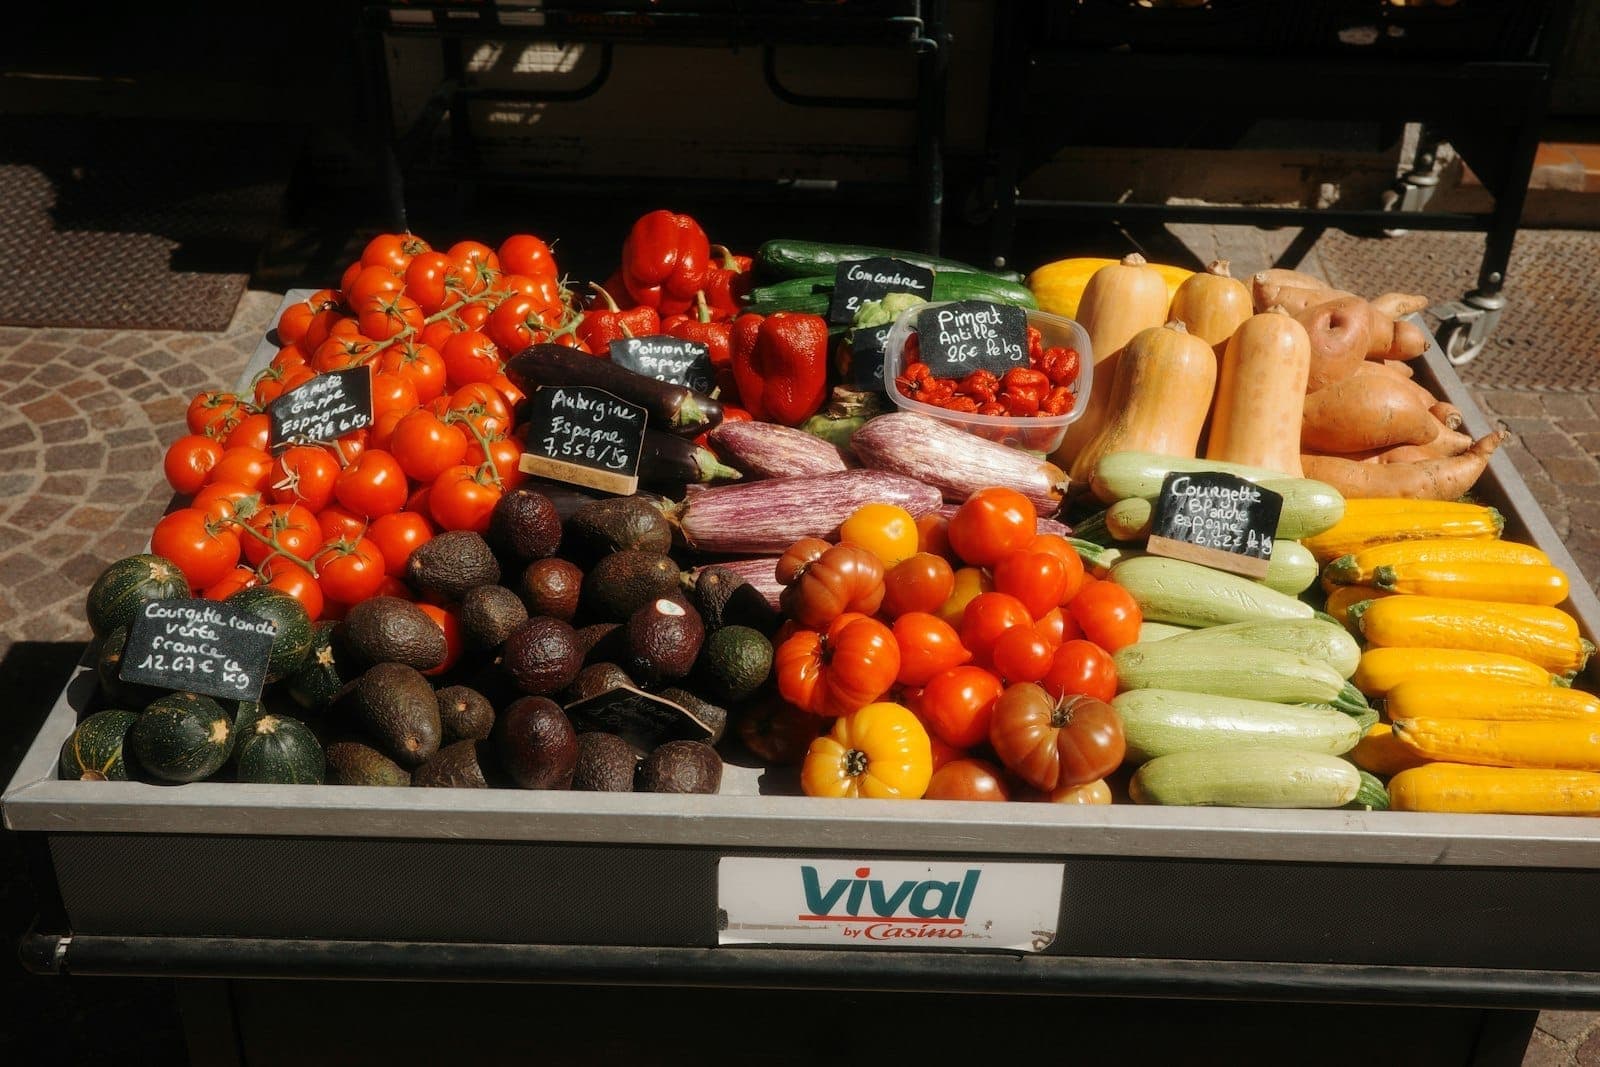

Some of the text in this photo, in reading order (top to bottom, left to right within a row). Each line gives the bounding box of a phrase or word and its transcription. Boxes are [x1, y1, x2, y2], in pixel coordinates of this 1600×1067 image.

[937, 305, 1003, 331] Piment
[939, 323, 998, 344] Antille
[628, 339, 684, 355] Poivron
[947, 338, 1022, 362] 26€ le kg
[551, 389, 636, 421] Aubergine
[281, 403, 357, 436] Espagne
[550, 416, 623, 443] Espagne
[1171, 477, 1262, 508] Courgette
[145, 602, 227, 626] Courgette
[166, 622, 220, 641] verte
[843, 923, 963, 941] by Casino
